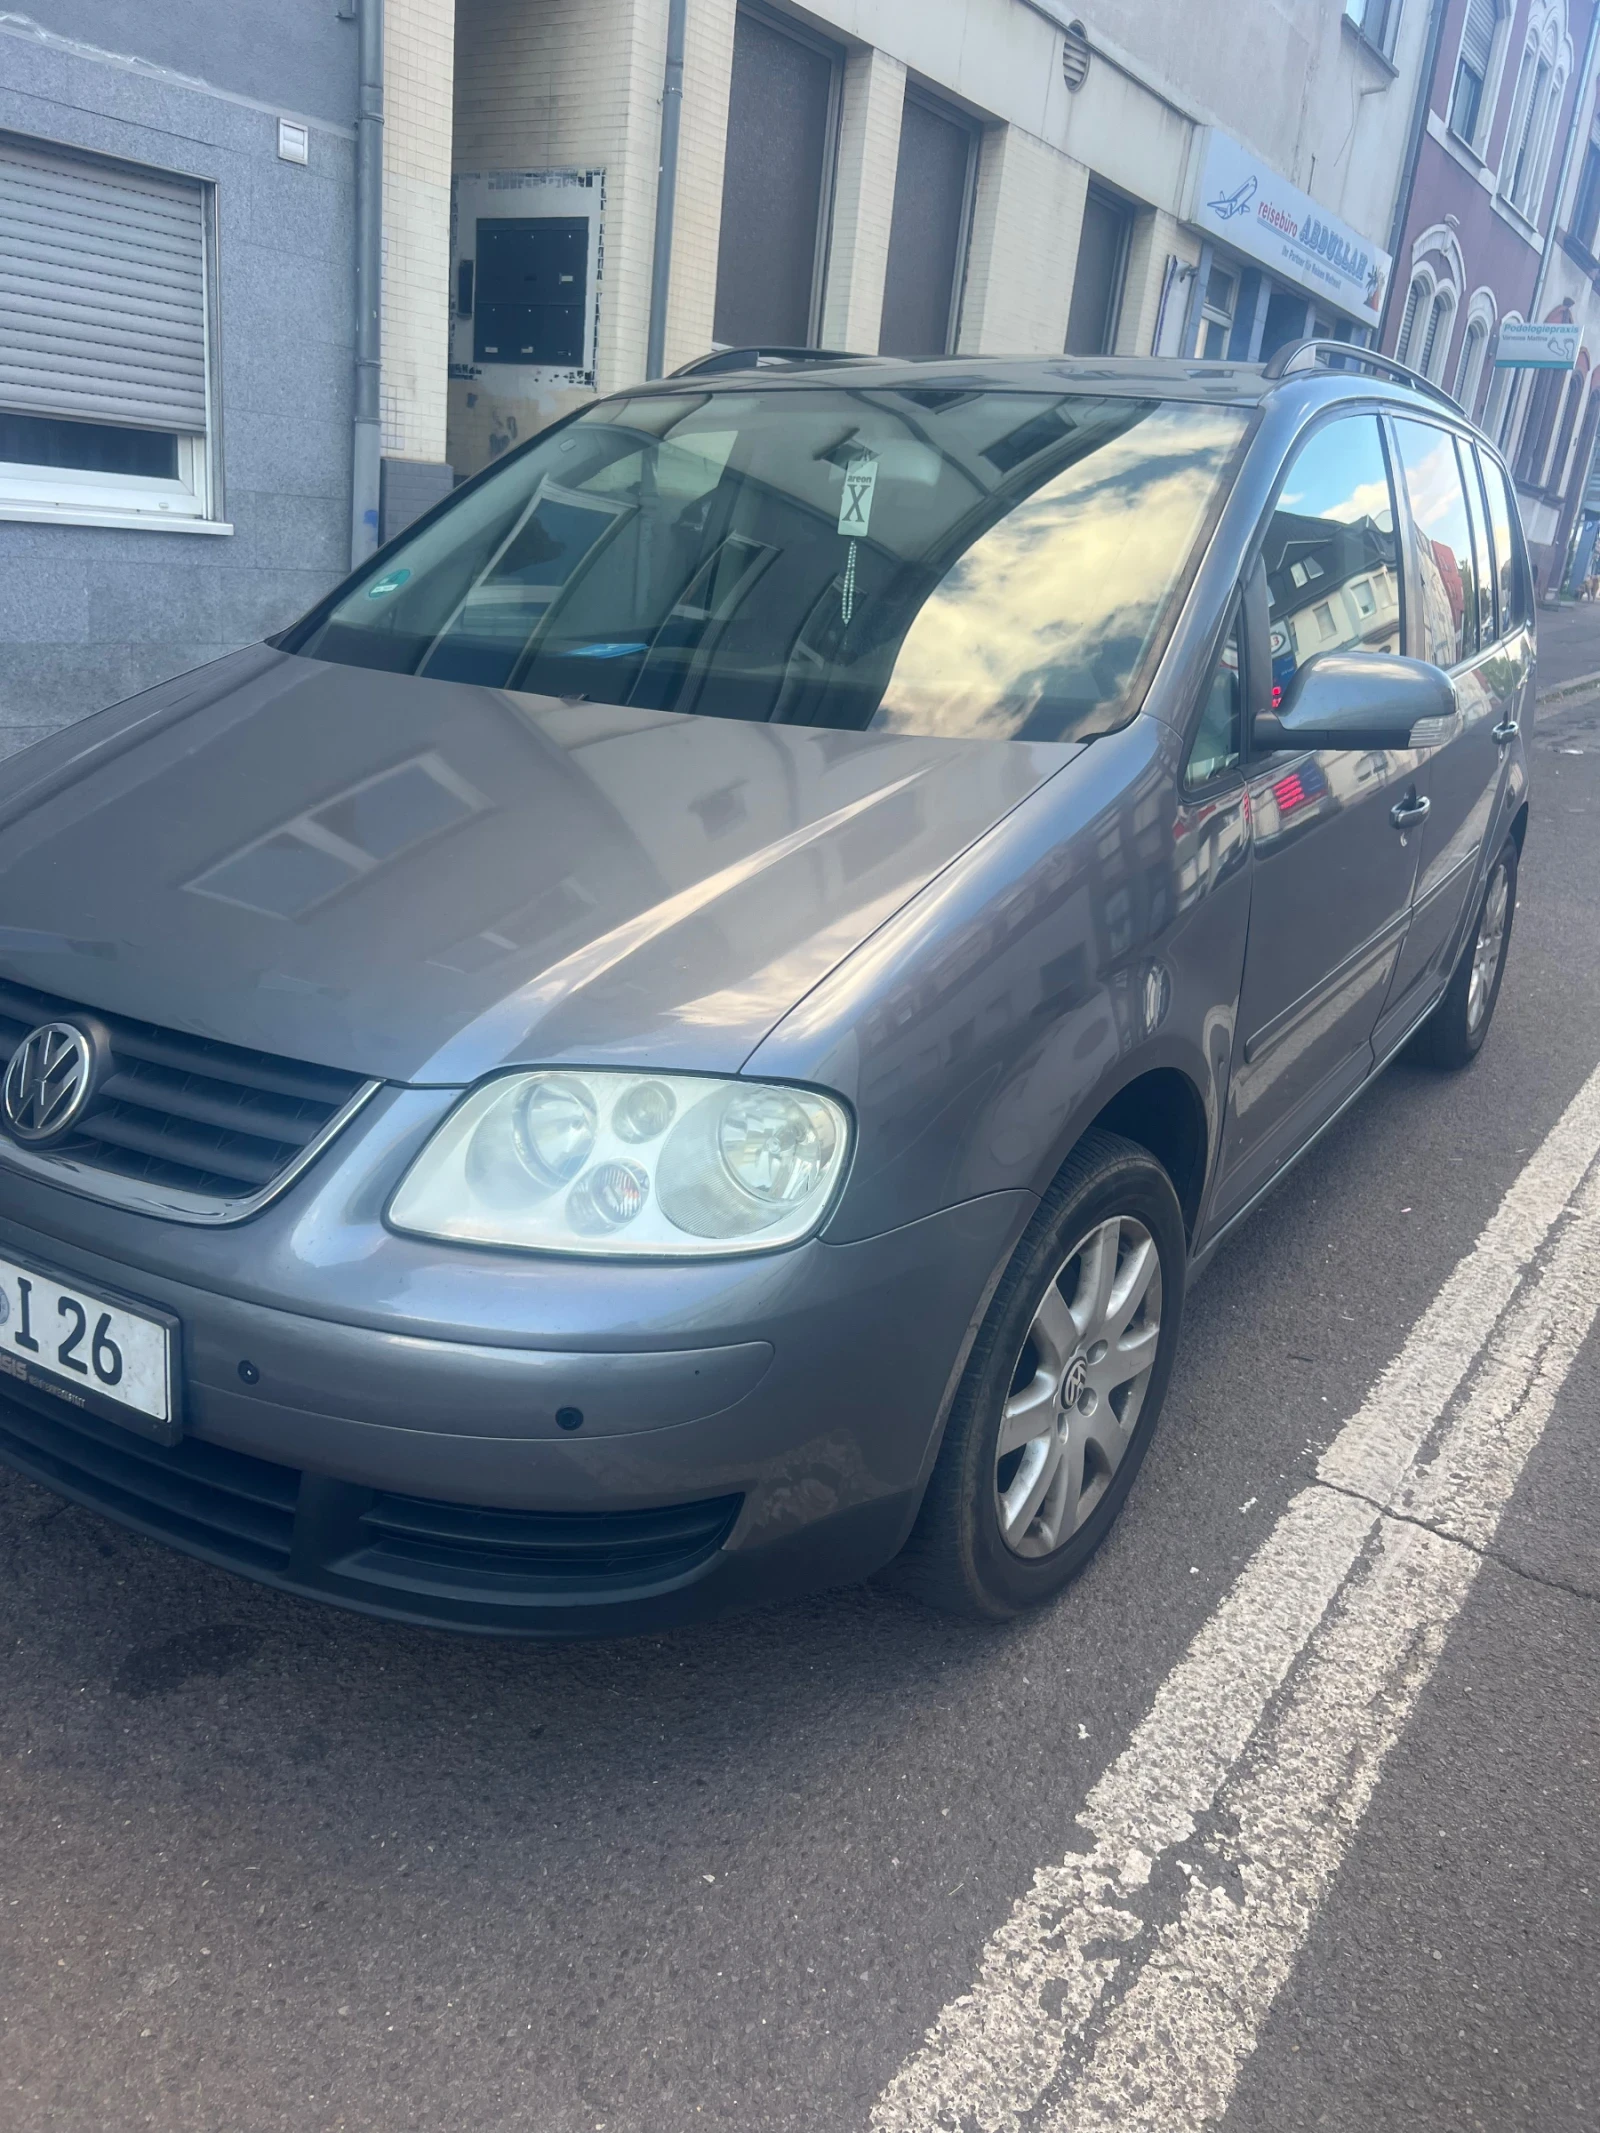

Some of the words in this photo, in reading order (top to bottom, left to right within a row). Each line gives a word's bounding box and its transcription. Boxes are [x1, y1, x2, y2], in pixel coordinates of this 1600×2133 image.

[1258, 201, 1298, 238] reisebüro
[1299, 214, 1368, 281] ABDULLAH
[1503, 323, 1579, 335] Podologiepraxis
[847, 474, 872, 483] areon
[841, 484, 871, 522] X
[15, 1276, 39, 1353] I
[58, 1296, 123, 1386] 26
